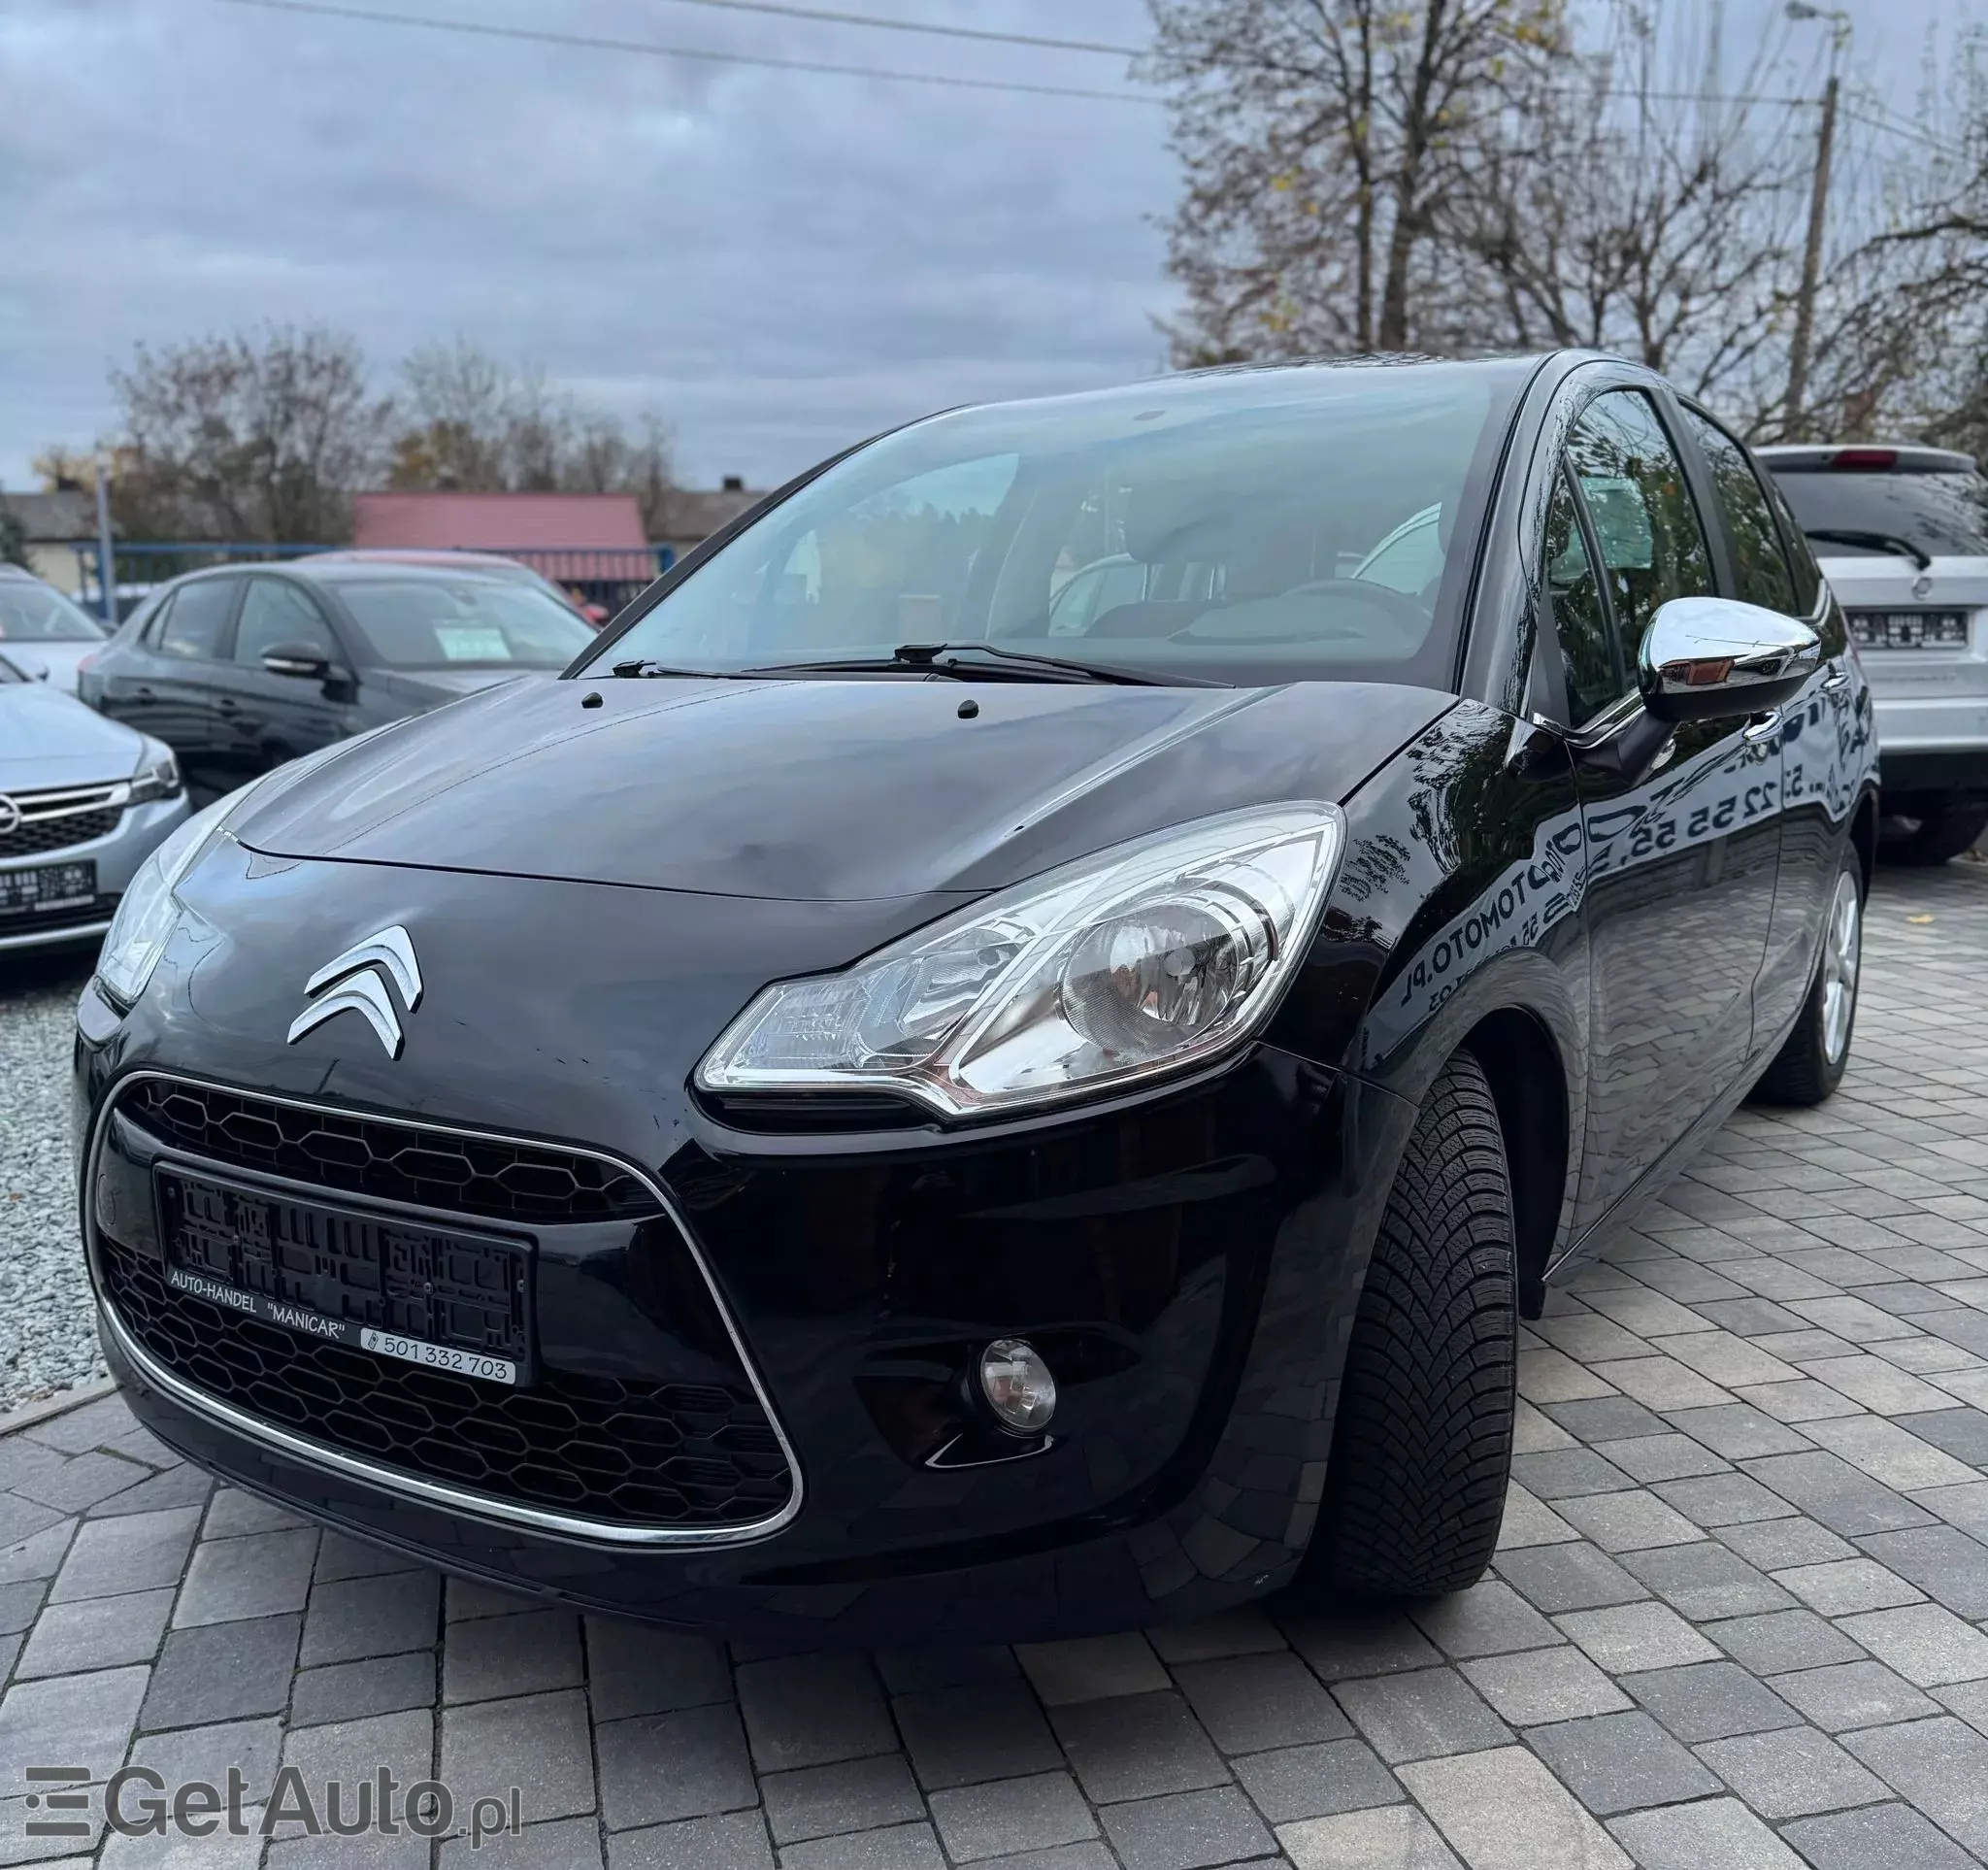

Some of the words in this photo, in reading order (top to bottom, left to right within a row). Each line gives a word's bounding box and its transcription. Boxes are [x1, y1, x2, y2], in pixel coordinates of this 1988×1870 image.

[171, 1271, 256, 1313] AUTO-HANDEL
[267, 1303, 345, 1339] "MANICAR"
[384, 1337, 418, 1360] 501
[424, 1347, 462, 1370] 332
[468, 1356, 507, 1380] 703
